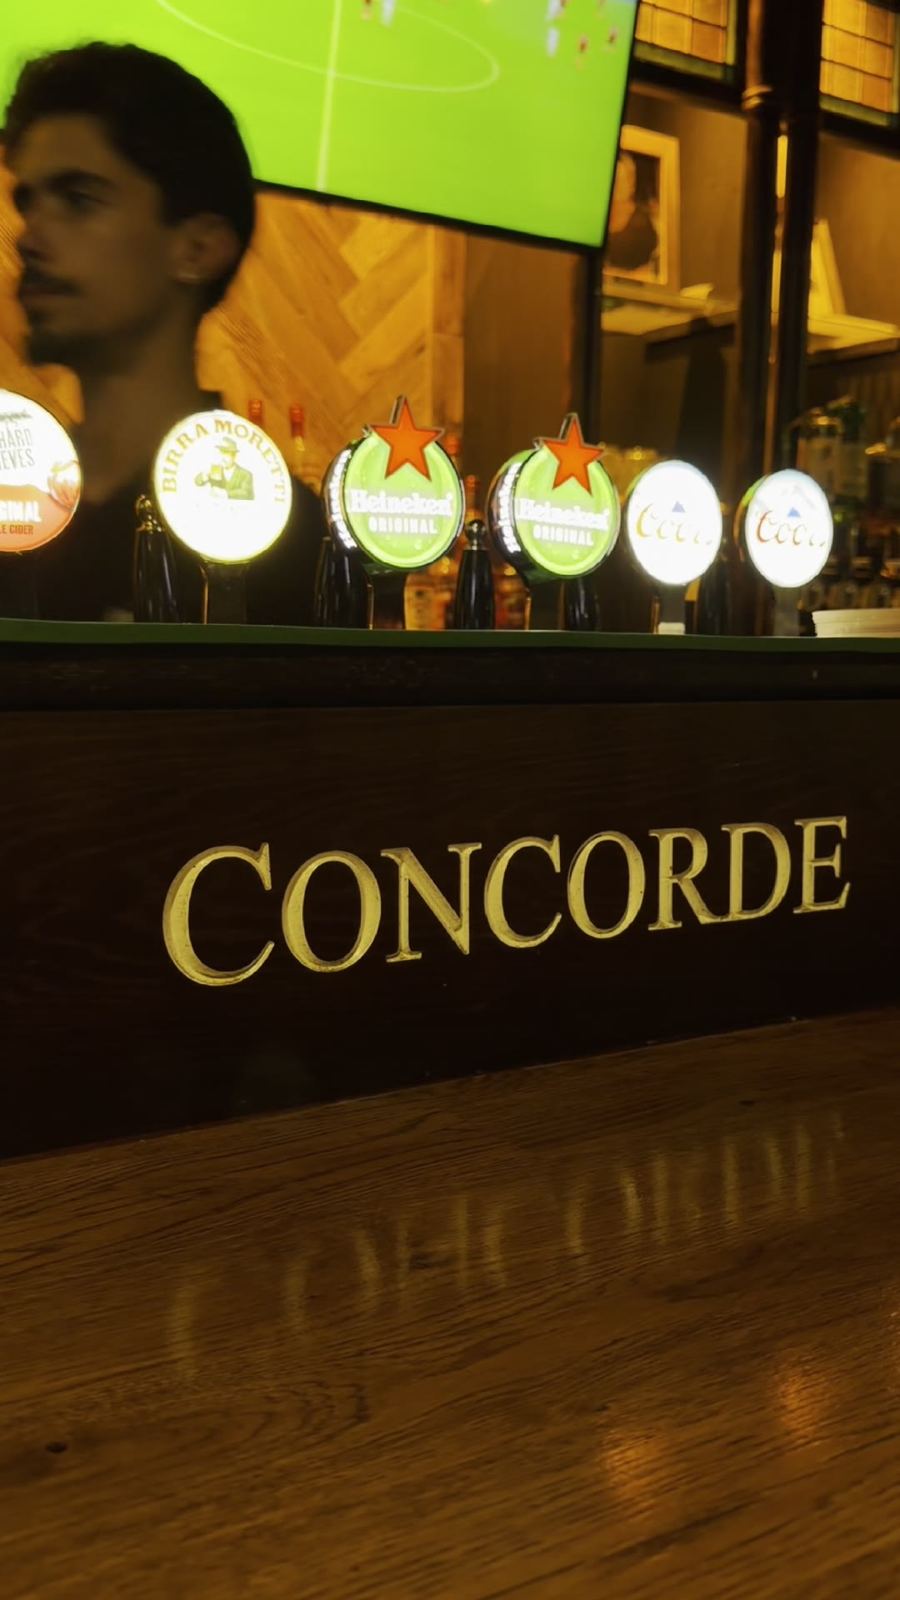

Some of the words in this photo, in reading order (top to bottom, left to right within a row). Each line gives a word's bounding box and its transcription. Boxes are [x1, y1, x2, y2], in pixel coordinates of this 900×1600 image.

[162, 422, 209, 494] BIRRA
[213, 418, 286, 503] MORETTI
[350, 488, 453, 517] Heineken
[518, 498, 610, 531] Heineken
[9, 524, 34, 536] CIDER
[368, 516, 438, 534] ORIGINAL
[533, 525, 594, 546] ORIGINAL
[162, 815, 850, 988] CONCORDE
